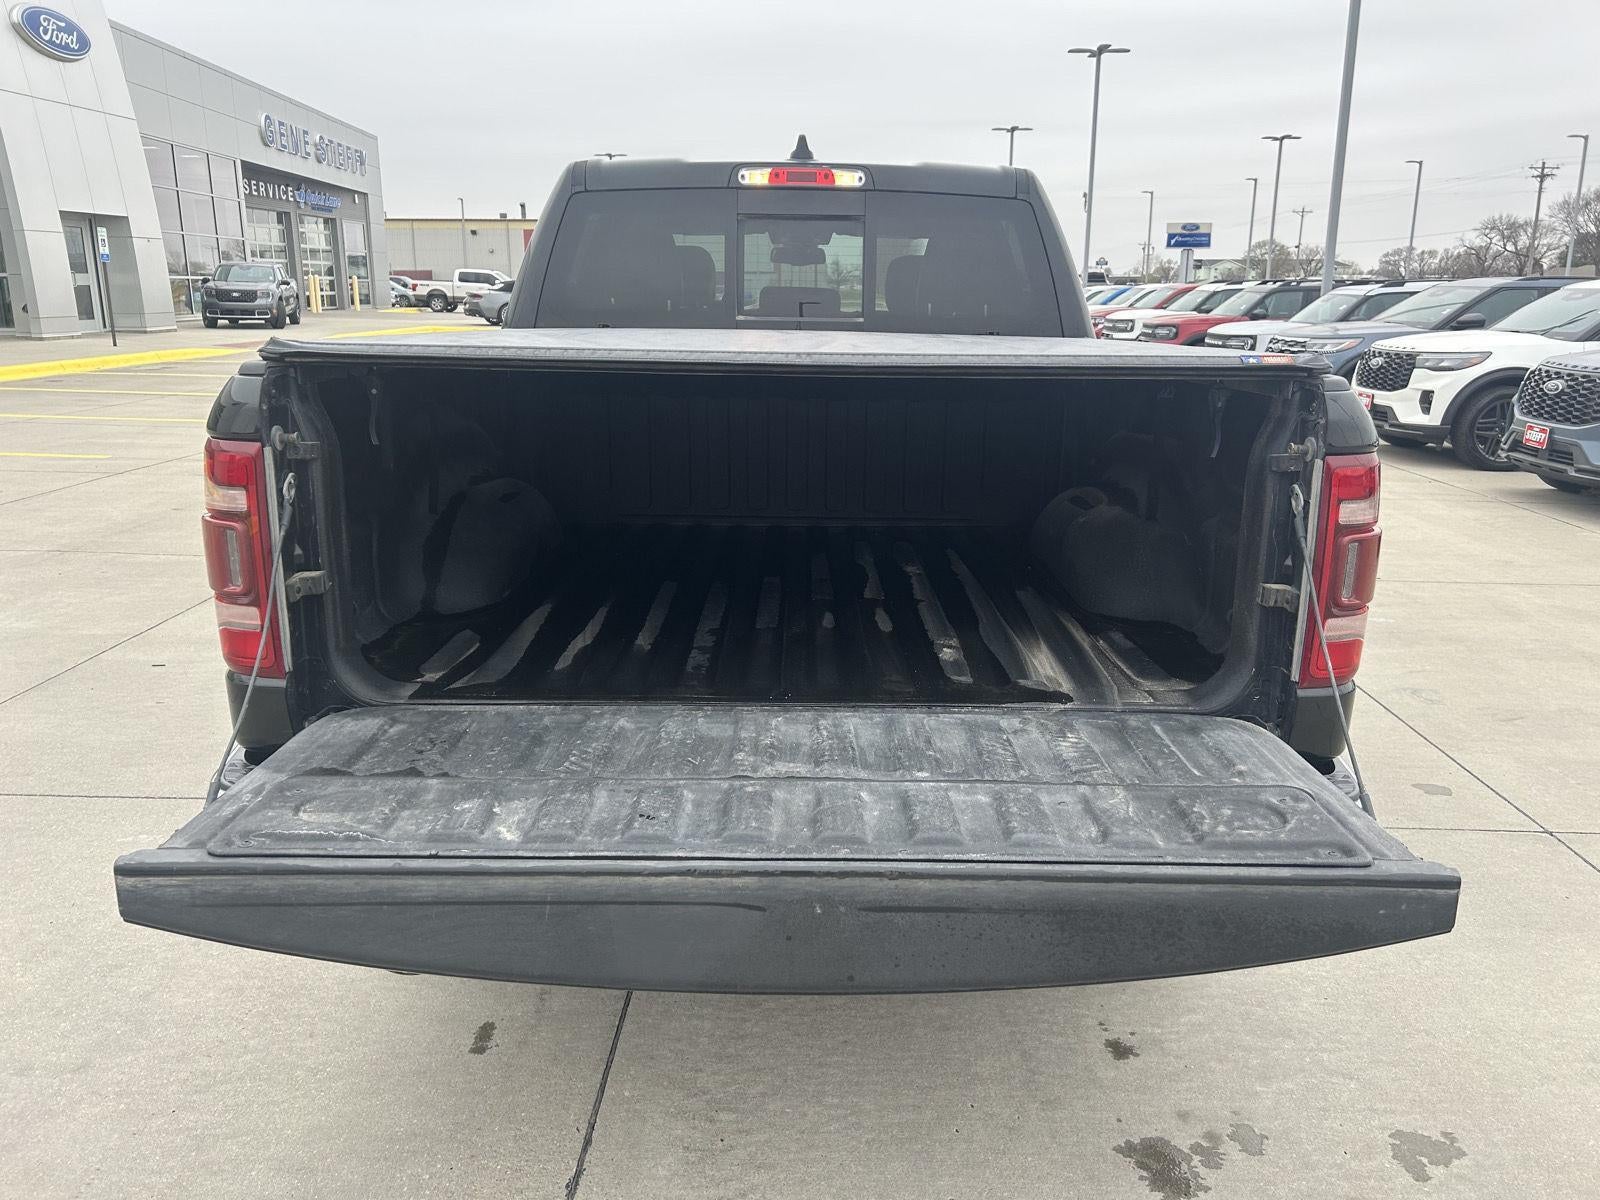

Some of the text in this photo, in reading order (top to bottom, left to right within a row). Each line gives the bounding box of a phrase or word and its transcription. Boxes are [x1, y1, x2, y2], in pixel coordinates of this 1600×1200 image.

[40, 15, 79, 49] Ford
[260, 112, 367, 176] GENE STEFFY
[243, 178, 294, 202] SERVICE
